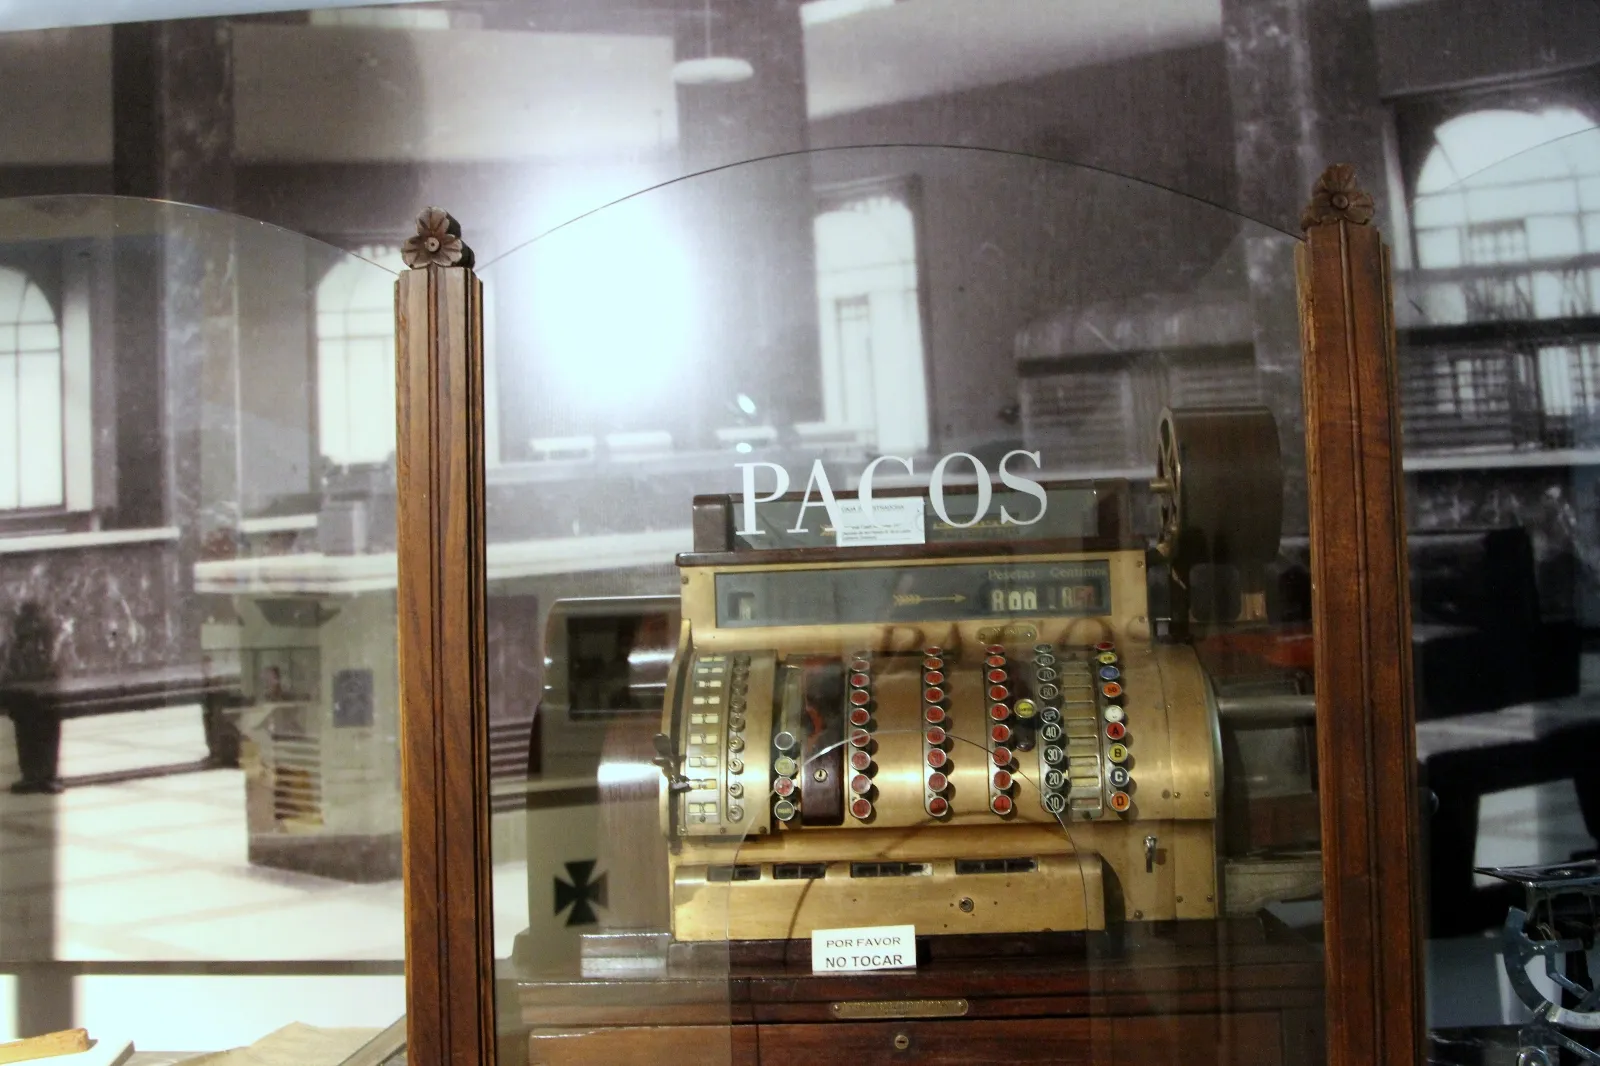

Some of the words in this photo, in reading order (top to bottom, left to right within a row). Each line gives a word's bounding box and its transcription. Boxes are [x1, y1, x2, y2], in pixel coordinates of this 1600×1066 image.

[1043, 687, 1053, 697] 60
[1046, 726, 1057, 738] 40
[1112, 727, 1120, 736] A
[1047, 748, 1058, 761] 30
[1114, 748, 1122, 757] B
[1049, 772, 1060, 785] 20
[1114, 771, 1123, 782] C
[1050, 797, 1060, 810] 10
[1116, 795, 1124, 806] D
[826, 939, 853, 948] POR
[856, 936, 901, 947] FAVOR
[826, 956, 847, 968] NO
[851, 954, 903, 967] TOCAR
